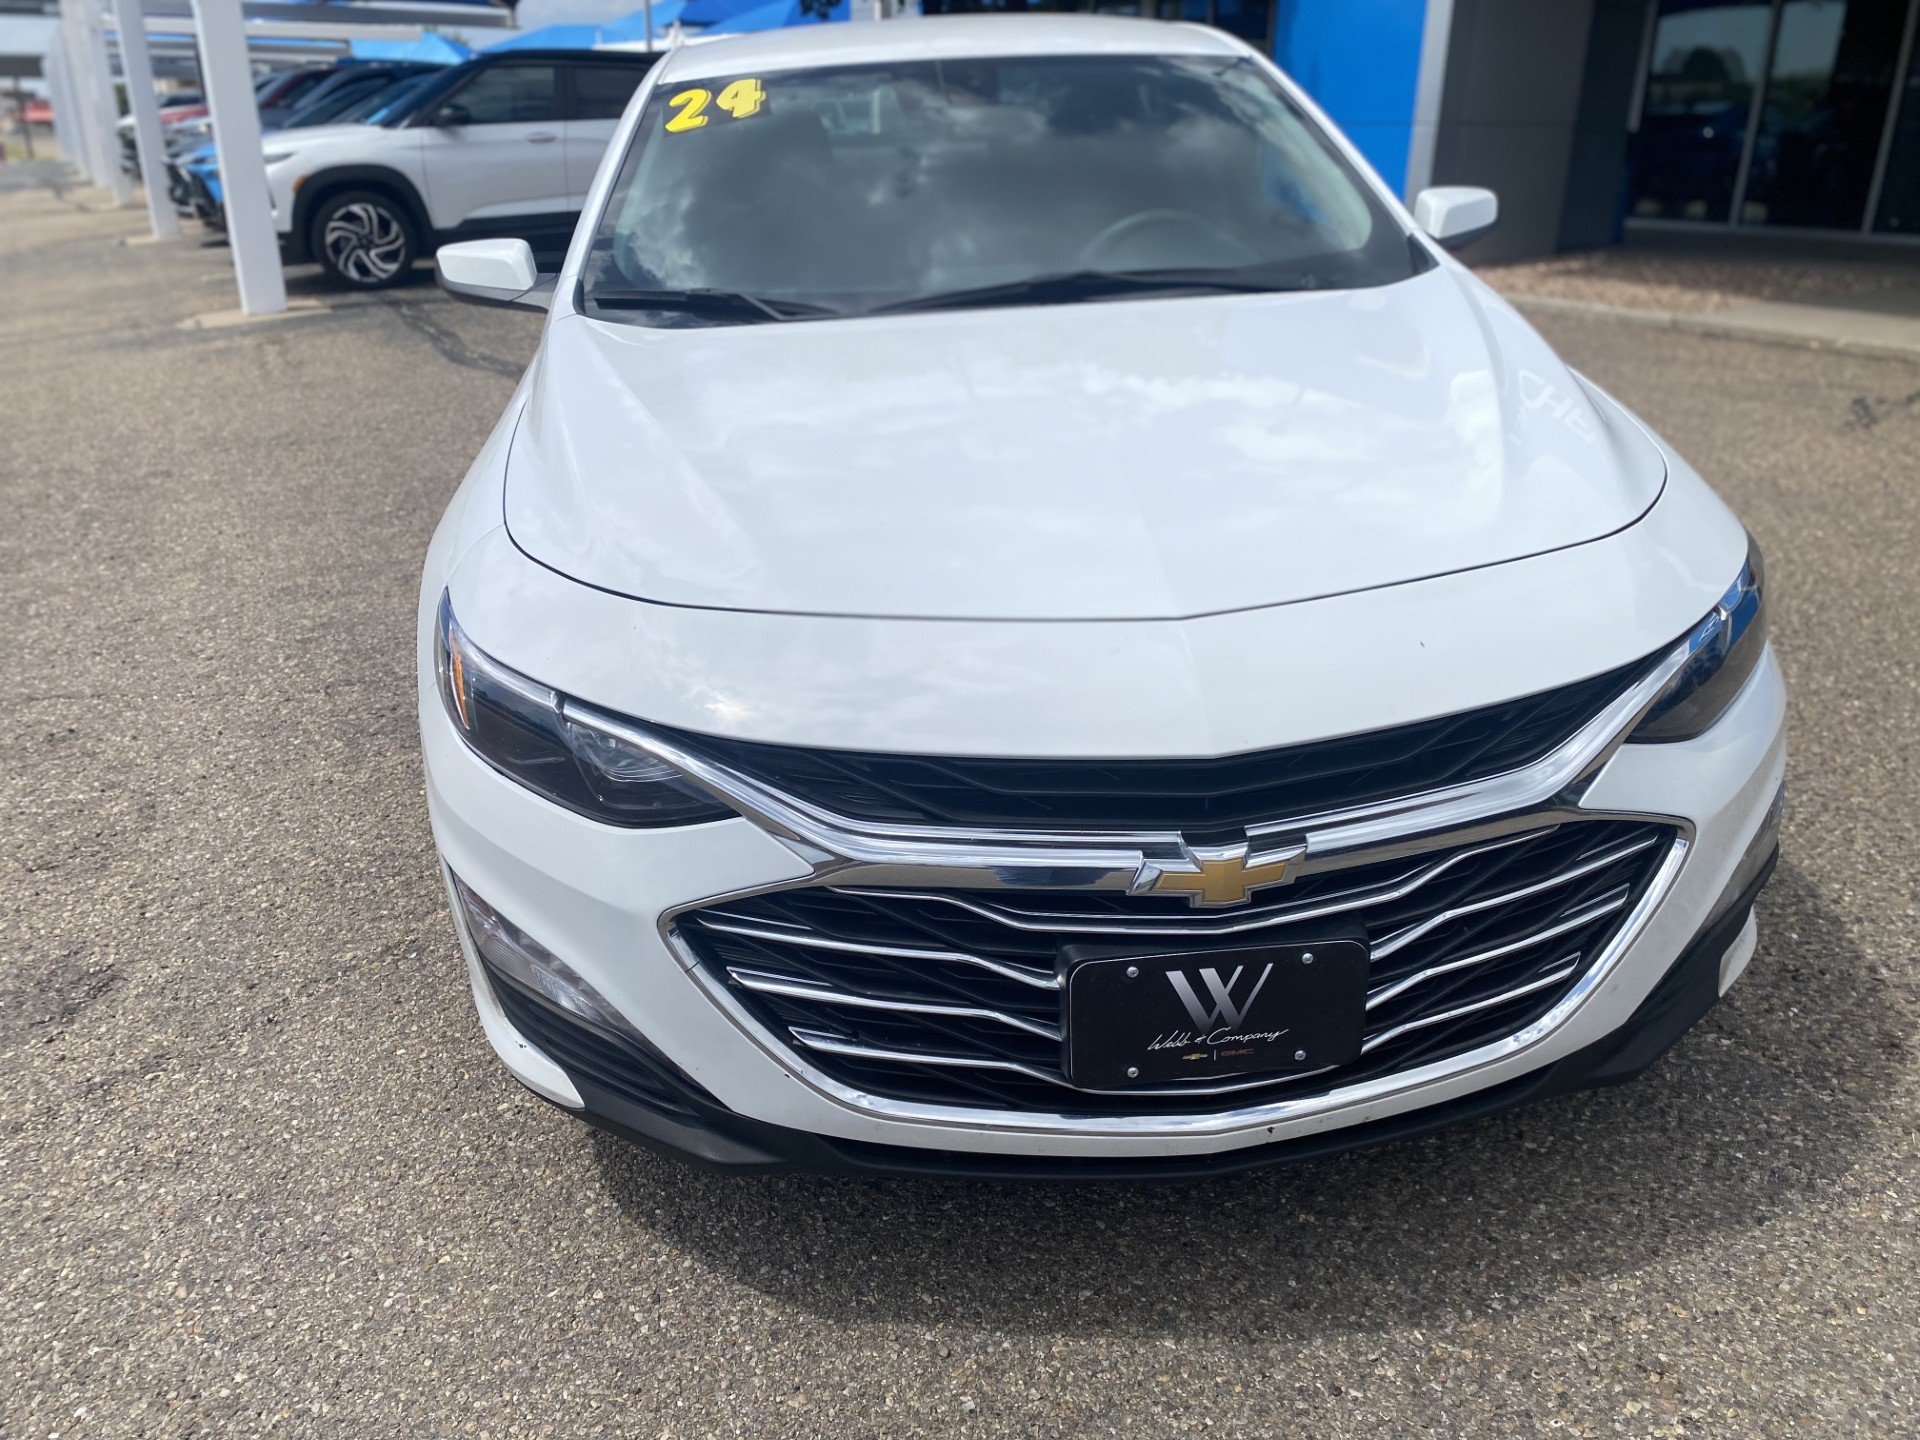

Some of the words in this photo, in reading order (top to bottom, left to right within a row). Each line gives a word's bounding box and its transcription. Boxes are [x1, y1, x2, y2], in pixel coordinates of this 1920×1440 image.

[665, 79, 766, 132] 24
[1147, 1030, 1191, 1050] Webb
[1206, 1026, 1289, 1045] Company
[1220, 1048, 1254, 1057] GMC
